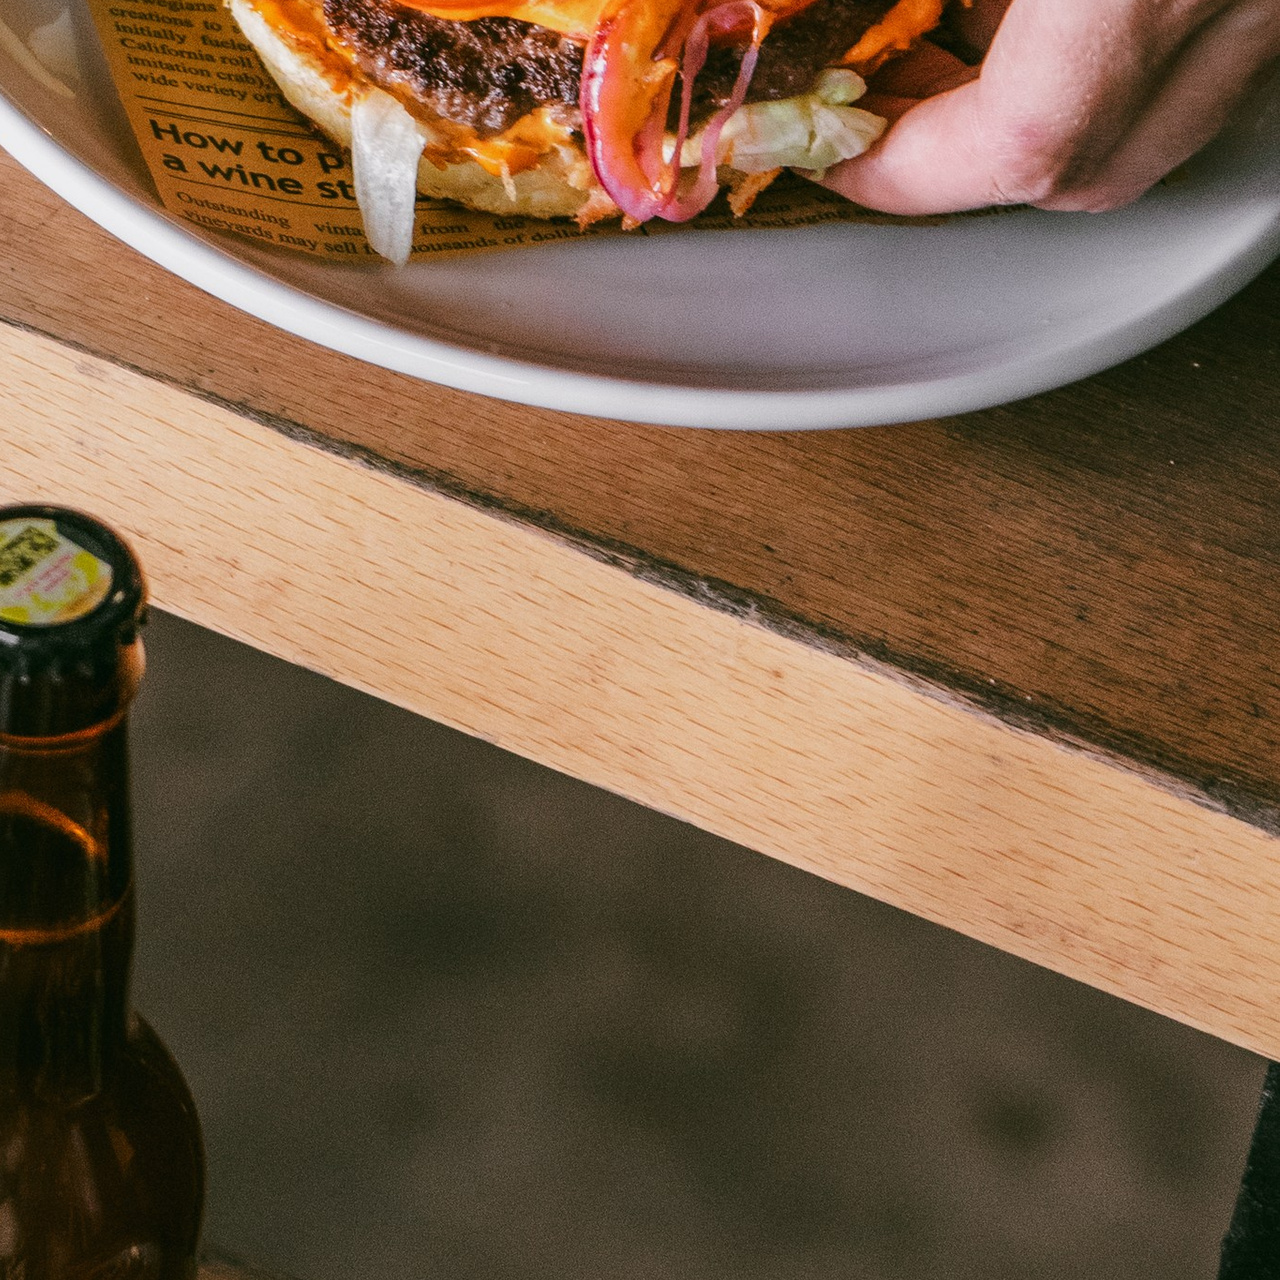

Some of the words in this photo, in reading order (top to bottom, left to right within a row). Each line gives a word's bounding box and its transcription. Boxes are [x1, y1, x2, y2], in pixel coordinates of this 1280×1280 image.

[108, 6, 195, 29] creations
[202, 20, 222, 33] to
[114, 21, 188, 45] initially
[120, 37, 217, 64] California
[220, 54, 253, 70] roll
[126, 53, 212, 79] imitation
[130, 70, 180, 89] wide
[181, 80, 249, 102] variety
[252, 90, 278, 105] of
[148, 118, 244, 157] How
[255, 140, 305, 167] to
[162, 151, 189, 174] a
[198, 160, 305, 196] wine
[176, 190, 291, 230] Outstanding
[421, 222, 470, 236] from
[183, 208, 273, 241] vineyards
[278, 232, 319, 252] may
[324, 239, 358, 256] sell
[504, 232, 526, 246] of
